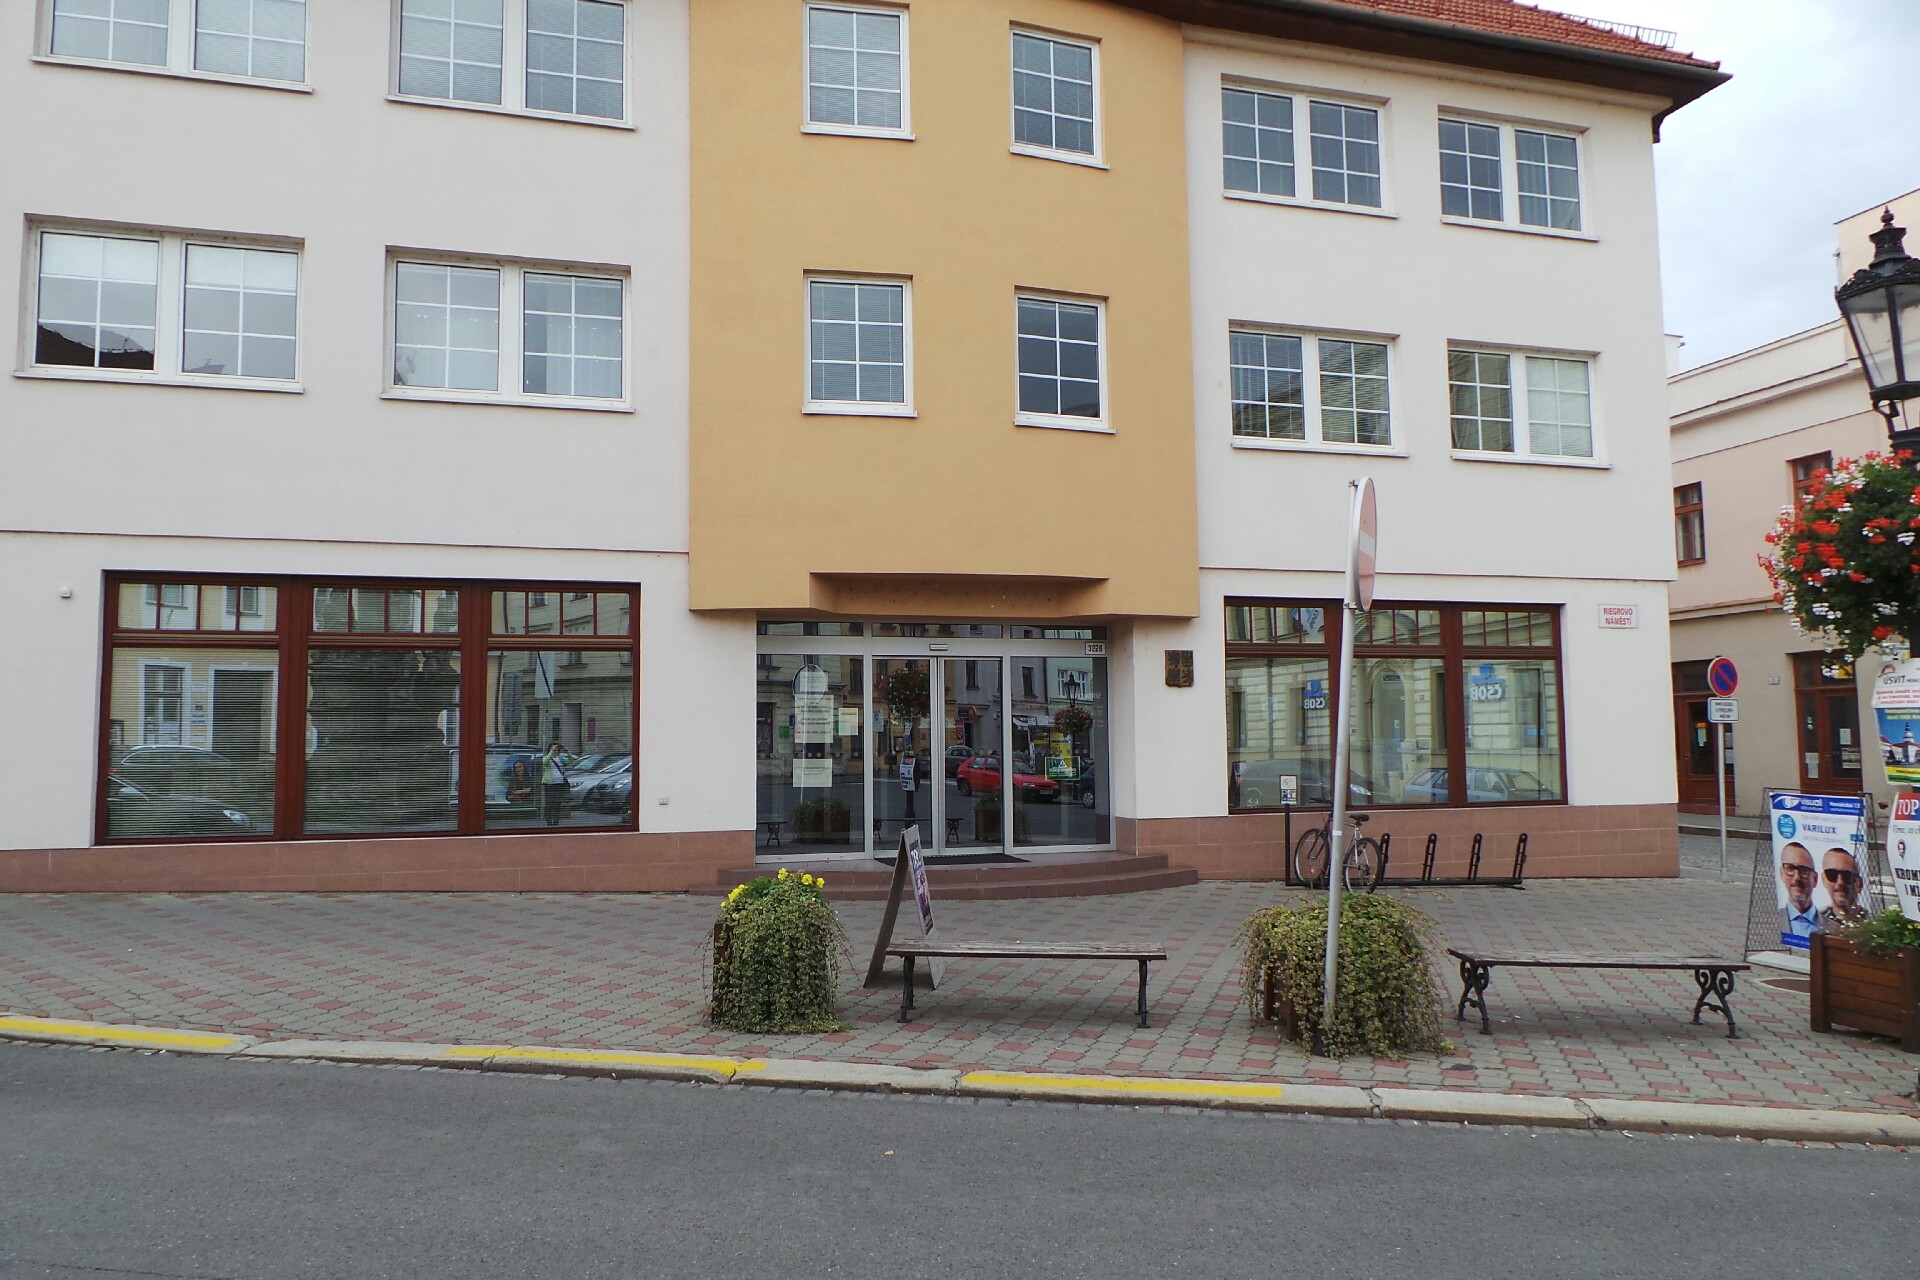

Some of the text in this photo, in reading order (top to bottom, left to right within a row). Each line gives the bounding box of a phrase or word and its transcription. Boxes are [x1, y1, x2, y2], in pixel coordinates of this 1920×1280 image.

[1603, 607, 1633, 616] RIEGROVO
[1897, 798, 1920, 816] TOP
[1802, 823, 1837, 834] VARILUX
